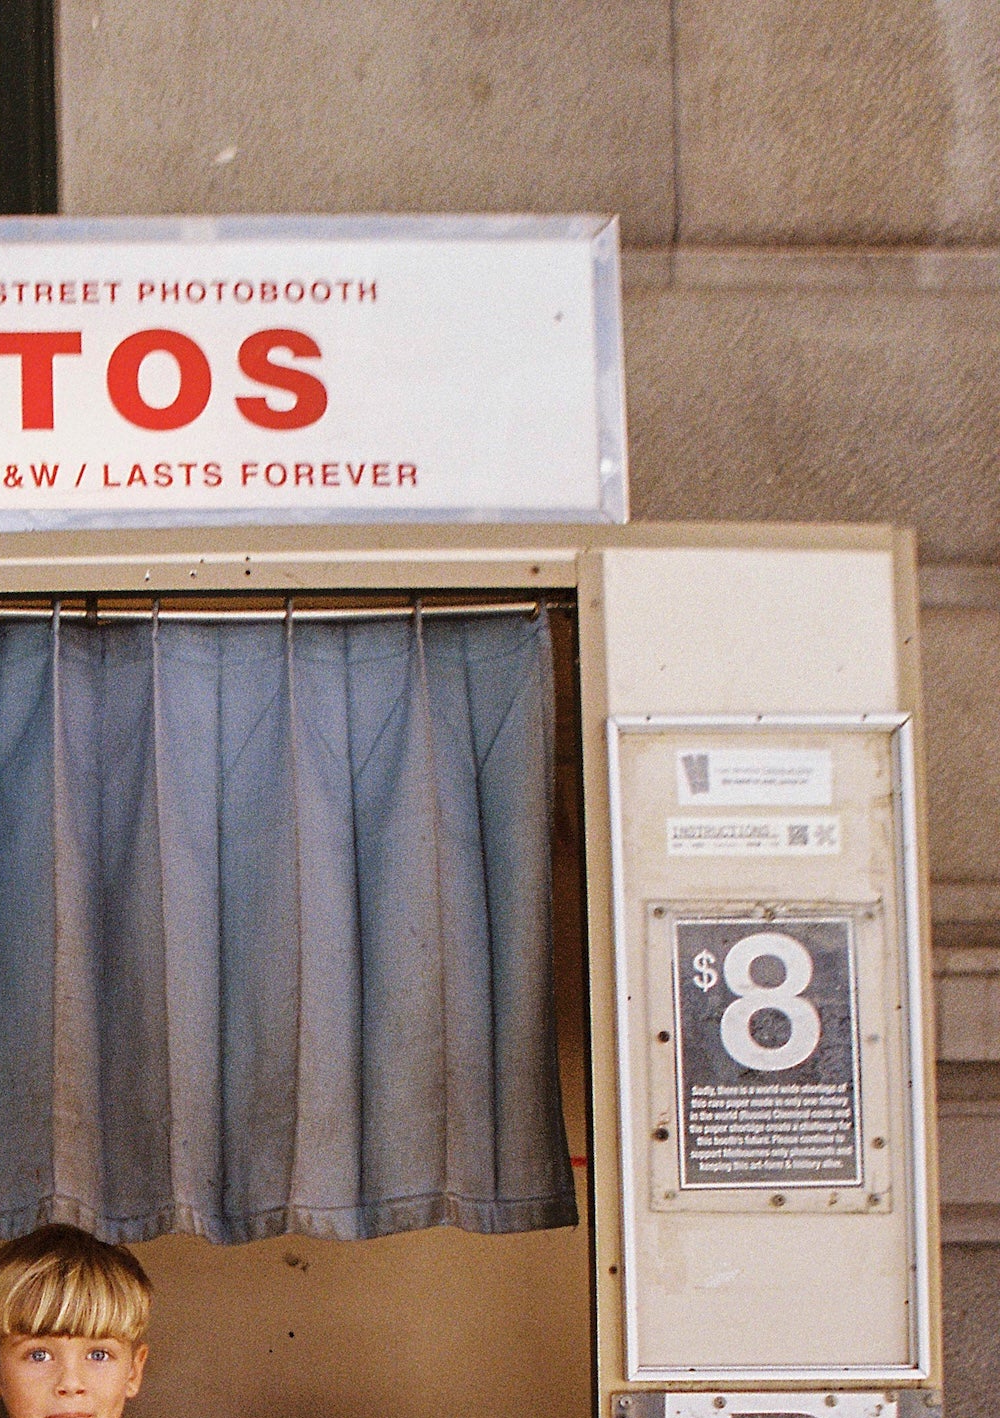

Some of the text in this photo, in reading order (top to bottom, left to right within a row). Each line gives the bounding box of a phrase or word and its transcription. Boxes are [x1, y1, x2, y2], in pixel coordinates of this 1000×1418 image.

[138, 281, 379, 304] PHOTOBOOTH
[103, 463, 223, 488] LASTS
[241, 463, 419, 488] FOREVER
[693, 932, 821, 1072] $8
